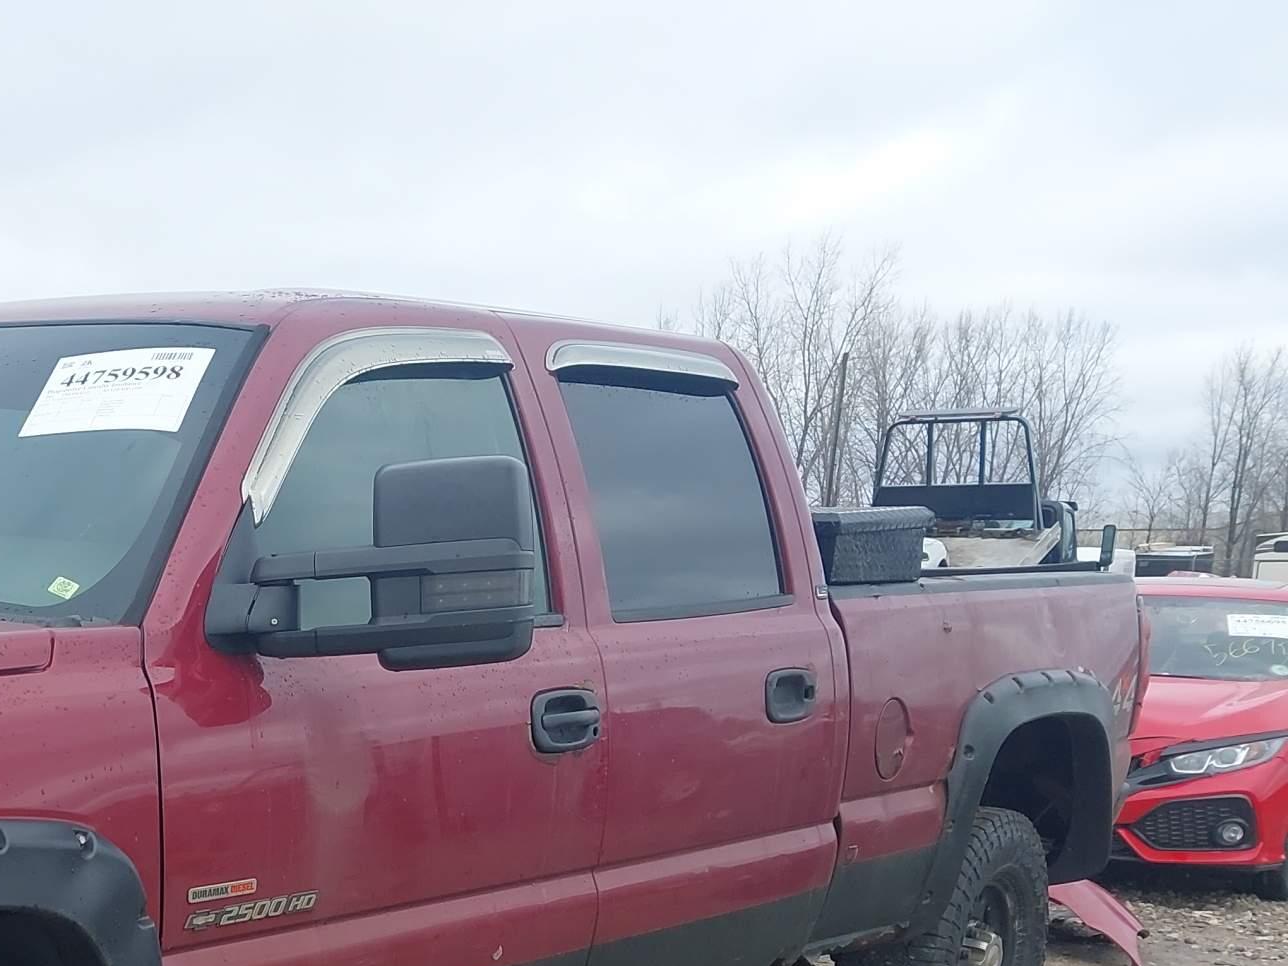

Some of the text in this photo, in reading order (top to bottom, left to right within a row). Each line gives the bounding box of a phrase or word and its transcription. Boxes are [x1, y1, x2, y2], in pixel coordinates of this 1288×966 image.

[60, 365, 184, 387] 44759598
[192, 882, 254, 900] DURAMAX DIESEL
[219, 891, 318, 926] 2500 HD
